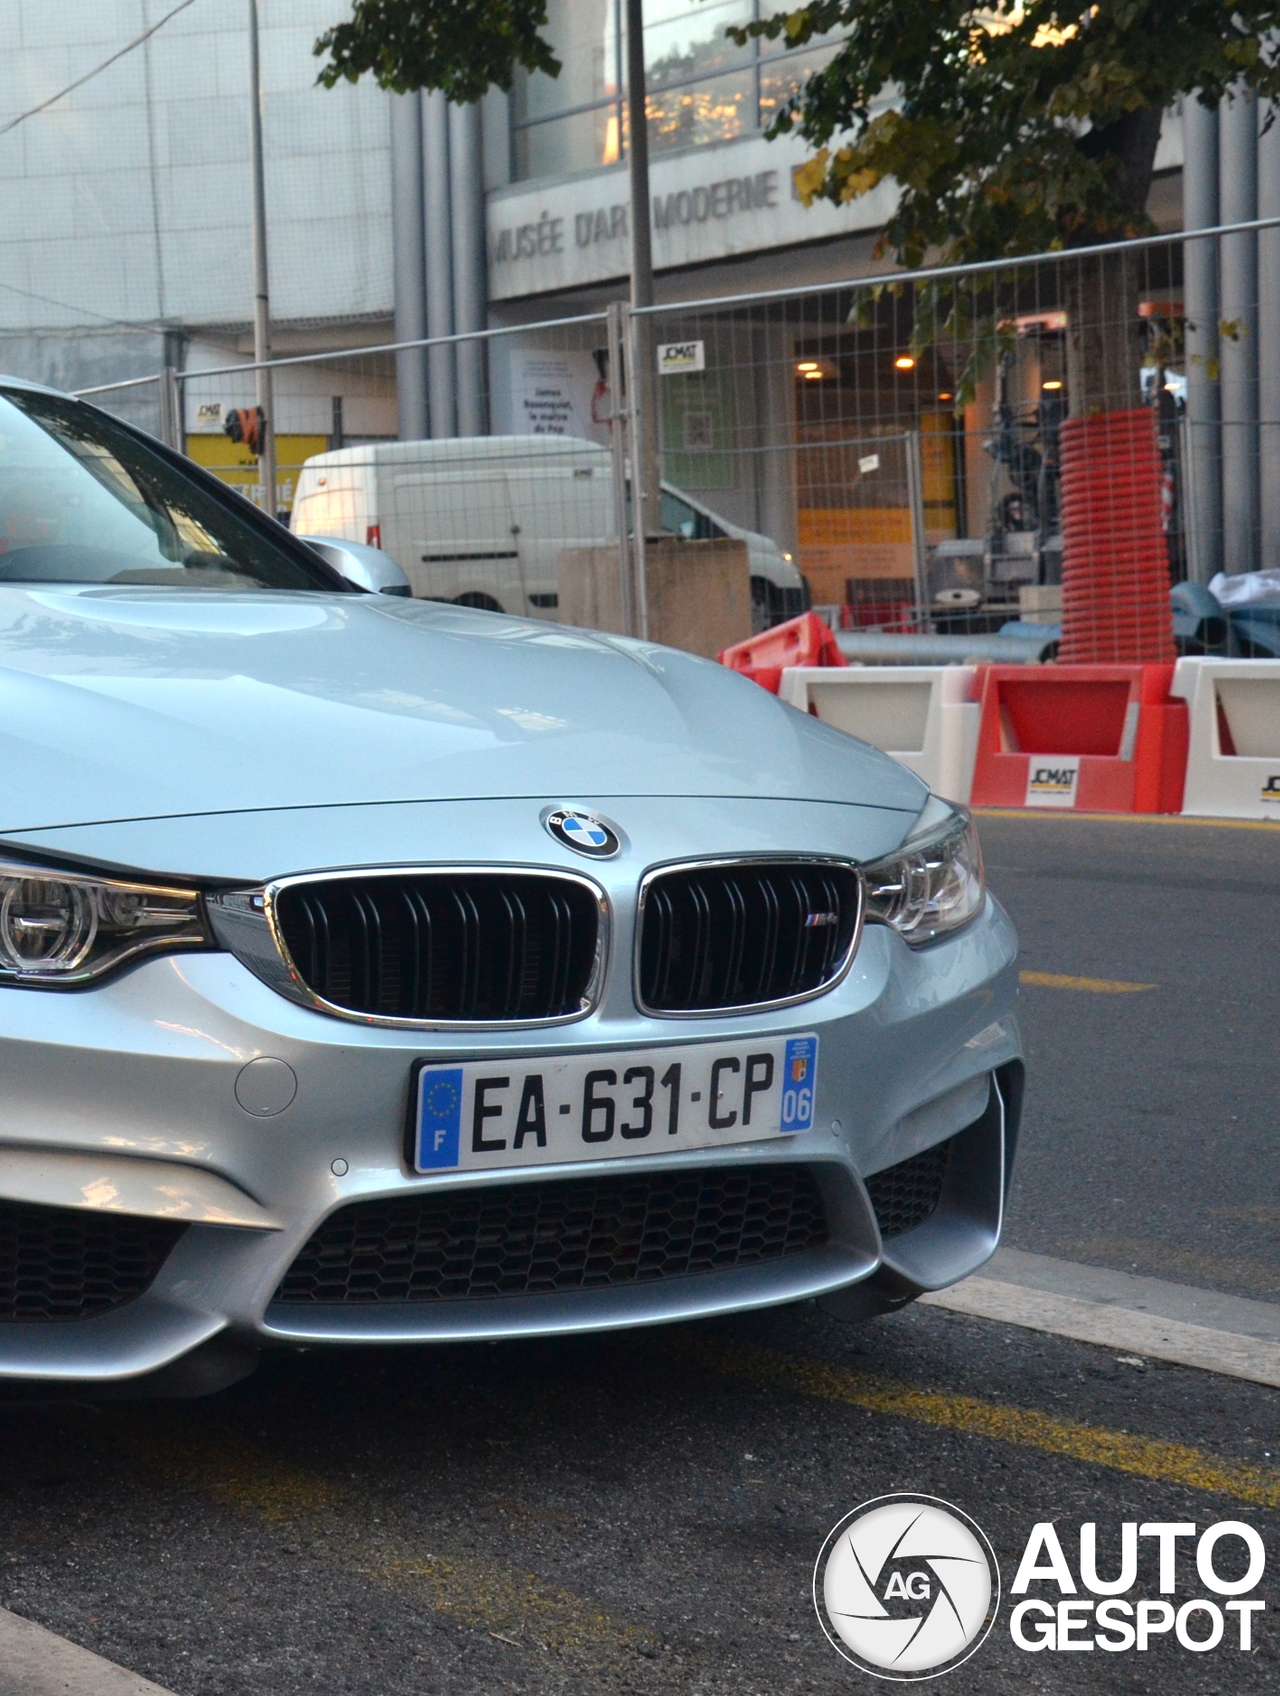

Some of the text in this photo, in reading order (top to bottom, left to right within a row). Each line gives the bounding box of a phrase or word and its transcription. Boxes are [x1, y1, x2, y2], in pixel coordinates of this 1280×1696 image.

[492, 169, 778, 264] MUSÉE D'AR MODERNE
[1030, 768, 1076, 784] JCMAT
[782, 1087, 812, 1124] 06
[433, 1129, 447, 1152] F
